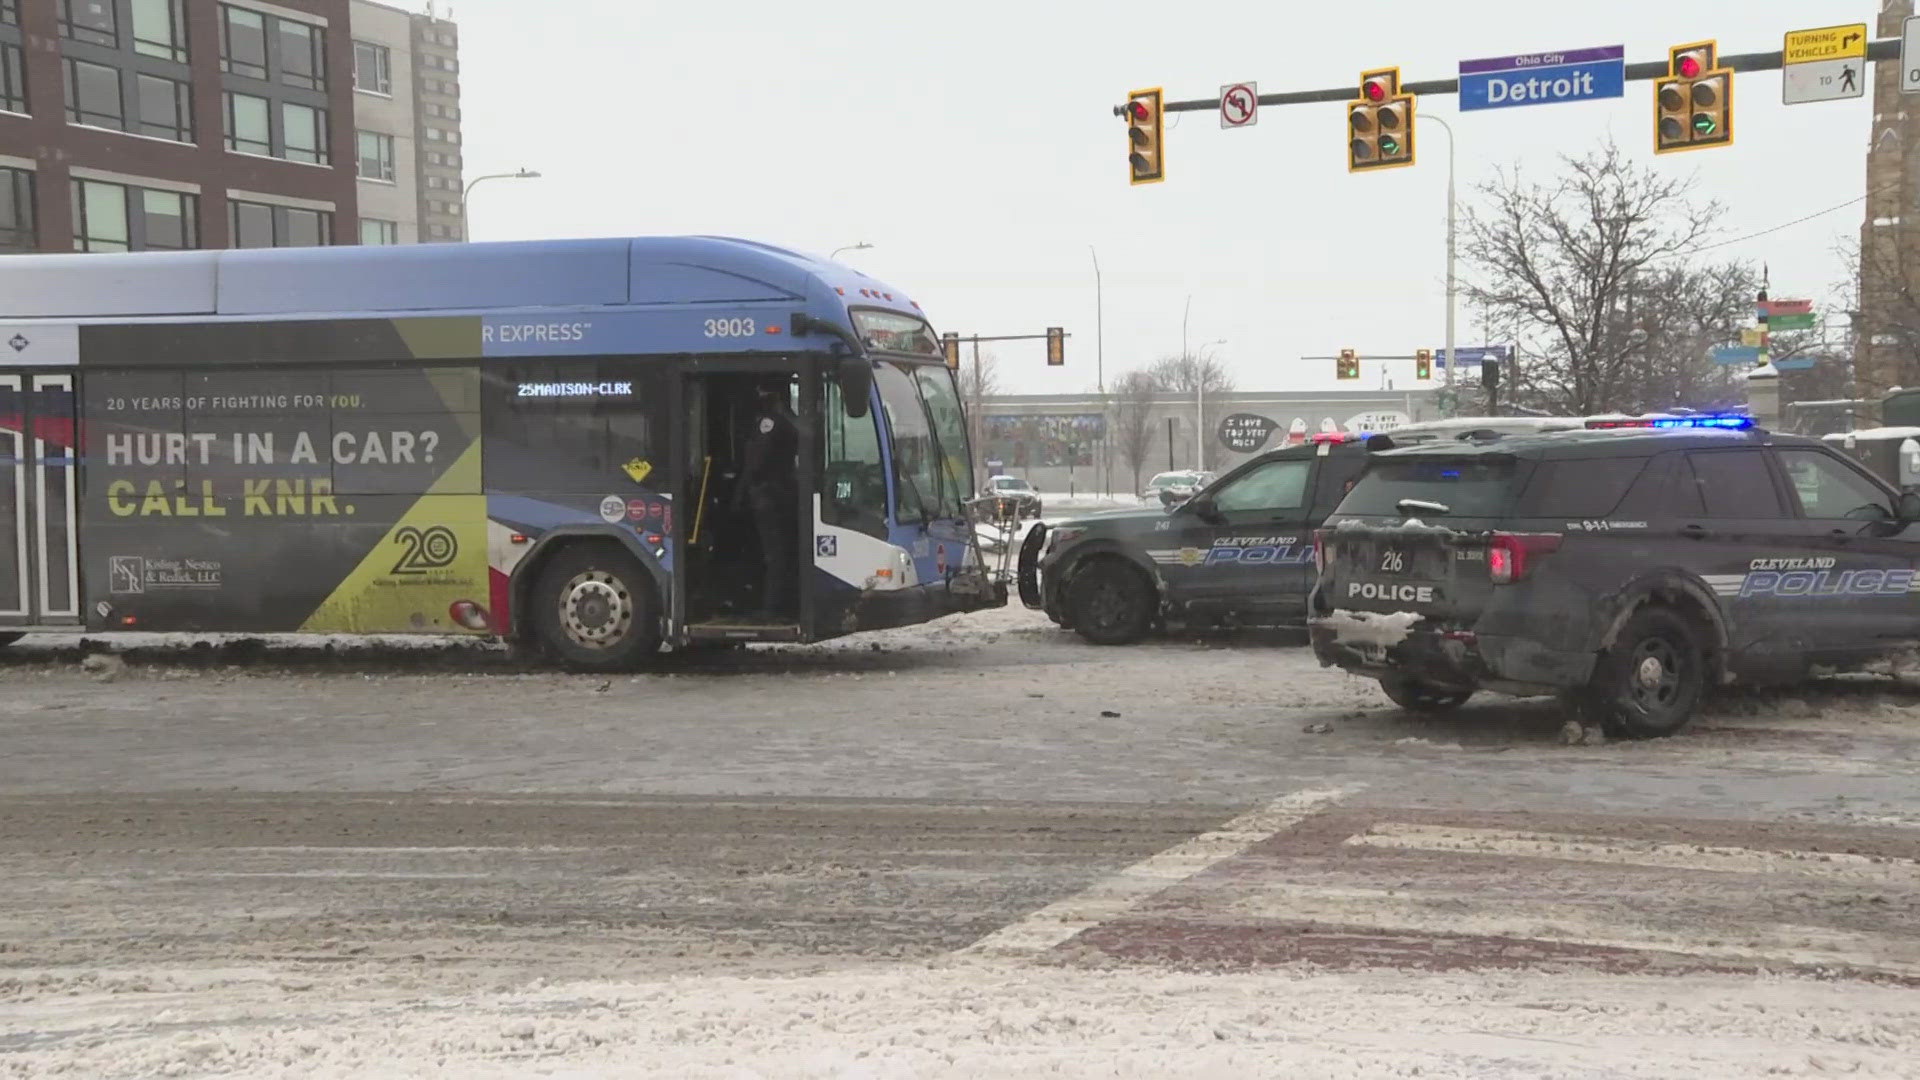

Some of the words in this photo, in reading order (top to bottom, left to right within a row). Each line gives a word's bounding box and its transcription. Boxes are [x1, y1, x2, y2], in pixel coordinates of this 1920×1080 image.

[1791, 32, 1837, 46] TURNING
[1515, 57, 1541, 66] Ohio
[1543, 54, 1565, 64] City
[1789, 45, 1838, 58] VEHICLES
[1488, 71, 1594, 103] Detroit
[1820, 75, 1832, 85] TO
[704, 317, 755, 338] 3903
[107, 397, 125, 410] 20
[132, 397, 182, 410] YEARS
[186, 396, 207, 409] OF
[213, 395, 288, 409] FIGHTING
[294, 395, 324, 408] FOR
[331, 394, 366, 408] YOU.
[107, 433, 217, 465] HURT
[234, 431, 274, 465] IN
[290, 431, 317, 464] A
[332, 430, 439, 465] CAR?
[107, 479, 226, 516] CALL
[244, 478, 355, 516] KNR.
[390, 525, 458, 575] 20
[1213, 536, 1297, 546] CLEVELAND
[1204, 545, 1315, 565] POLI
[1381, 551, 1402, 572] 216
[1750, 557, 1836, 570] CLEVELAND
[145, 571, 155, 582] &
[1738, 569, 1915, 598] POLICE
[1348, 583, 1433, 602] POLICE
